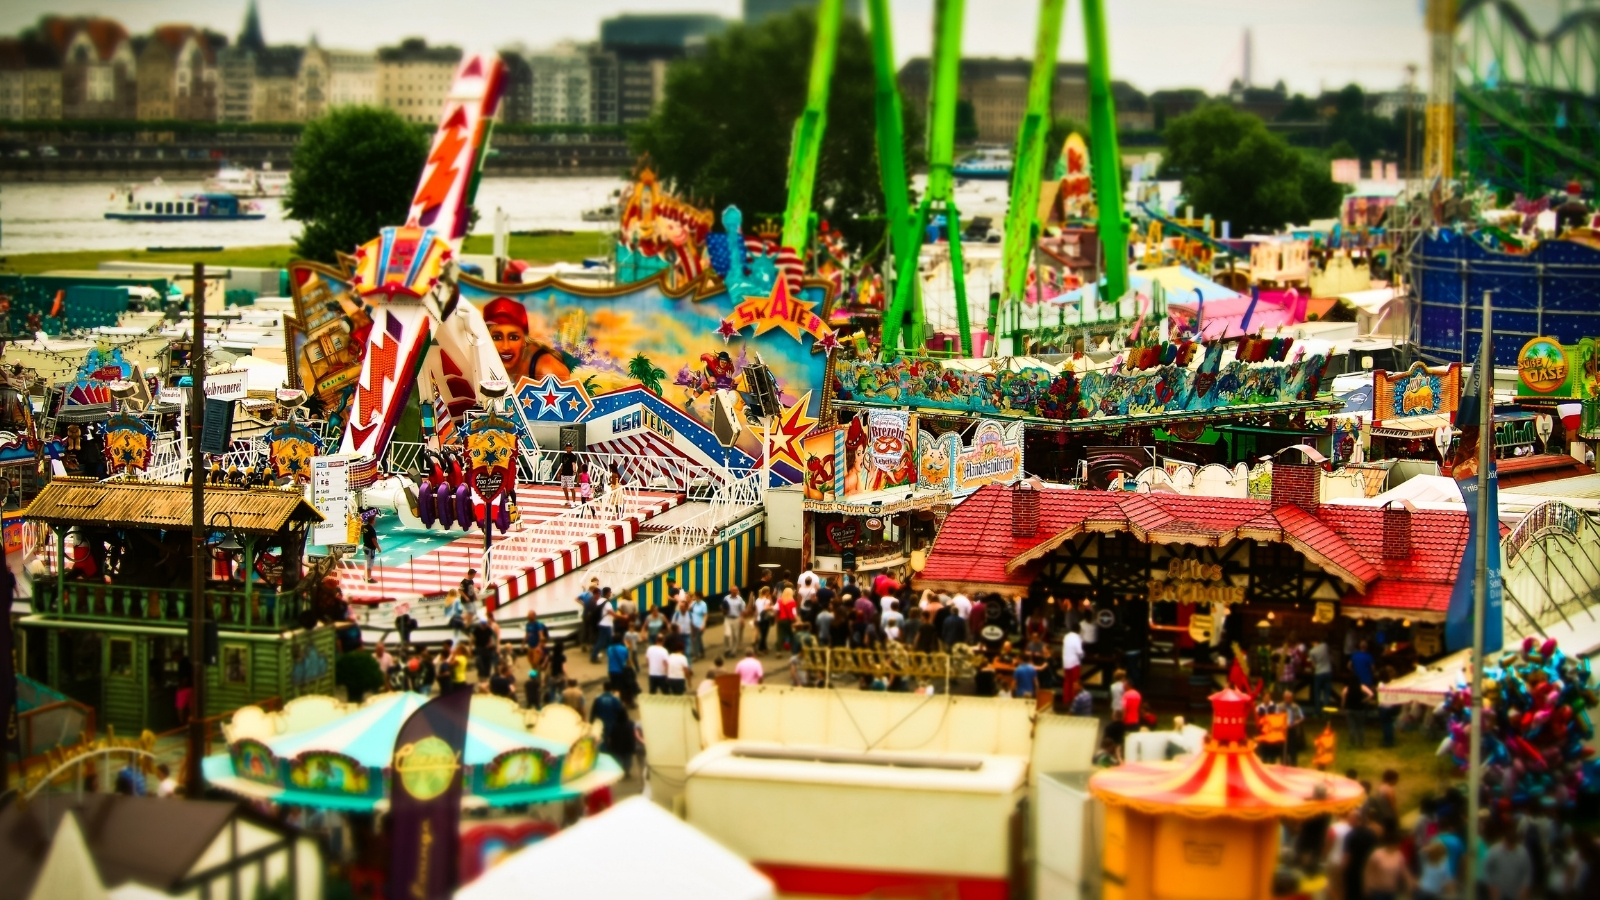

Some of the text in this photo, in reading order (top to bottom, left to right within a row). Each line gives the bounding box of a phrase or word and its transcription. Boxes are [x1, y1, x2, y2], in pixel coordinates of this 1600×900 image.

[1529, 366, 1565, 382] OASE
[612, 410, 641, 434] USA
[643, 408, 674, 442] TEAM
[871, 426, 905, 440] Brezeln
[804, 501, 865, 513] BUTTER OLIVEN
